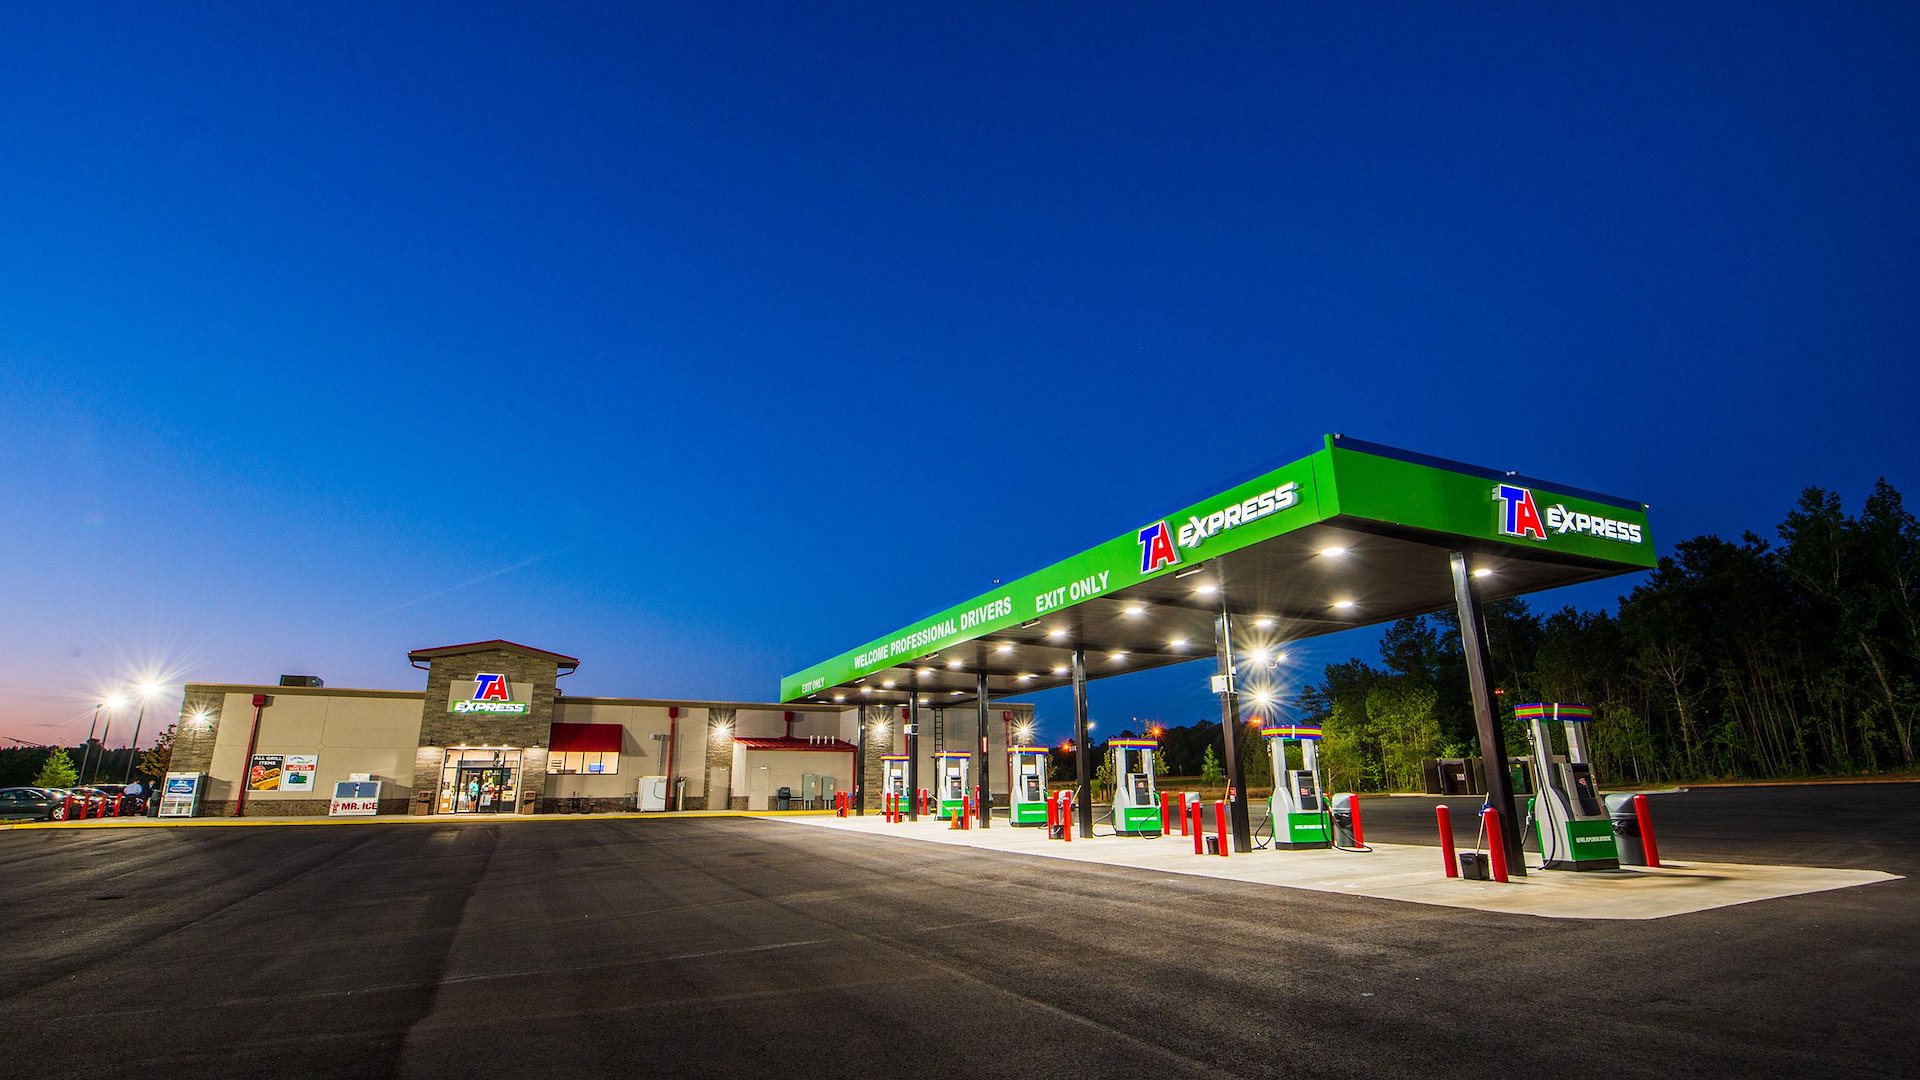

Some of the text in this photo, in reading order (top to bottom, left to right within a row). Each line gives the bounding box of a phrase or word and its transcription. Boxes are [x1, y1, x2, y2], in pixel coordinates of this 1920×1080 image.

[1138, 482, 1298, 574] TA EXPRESS
[1499, 484, 1642, 543] TA EXPRESS
[1035, 570, 1110, 613] EXIT ONLY
[854, 596, 1012, 669] WELCOME PROFESSIONAL DRIVERS
[473, 673, 509, 701] TA
[801, 676, 825, 693] EXIT ONLY
[454, 700, 525, 713] EXPRESS
[341, 802, 378, 811] MR. ICE
